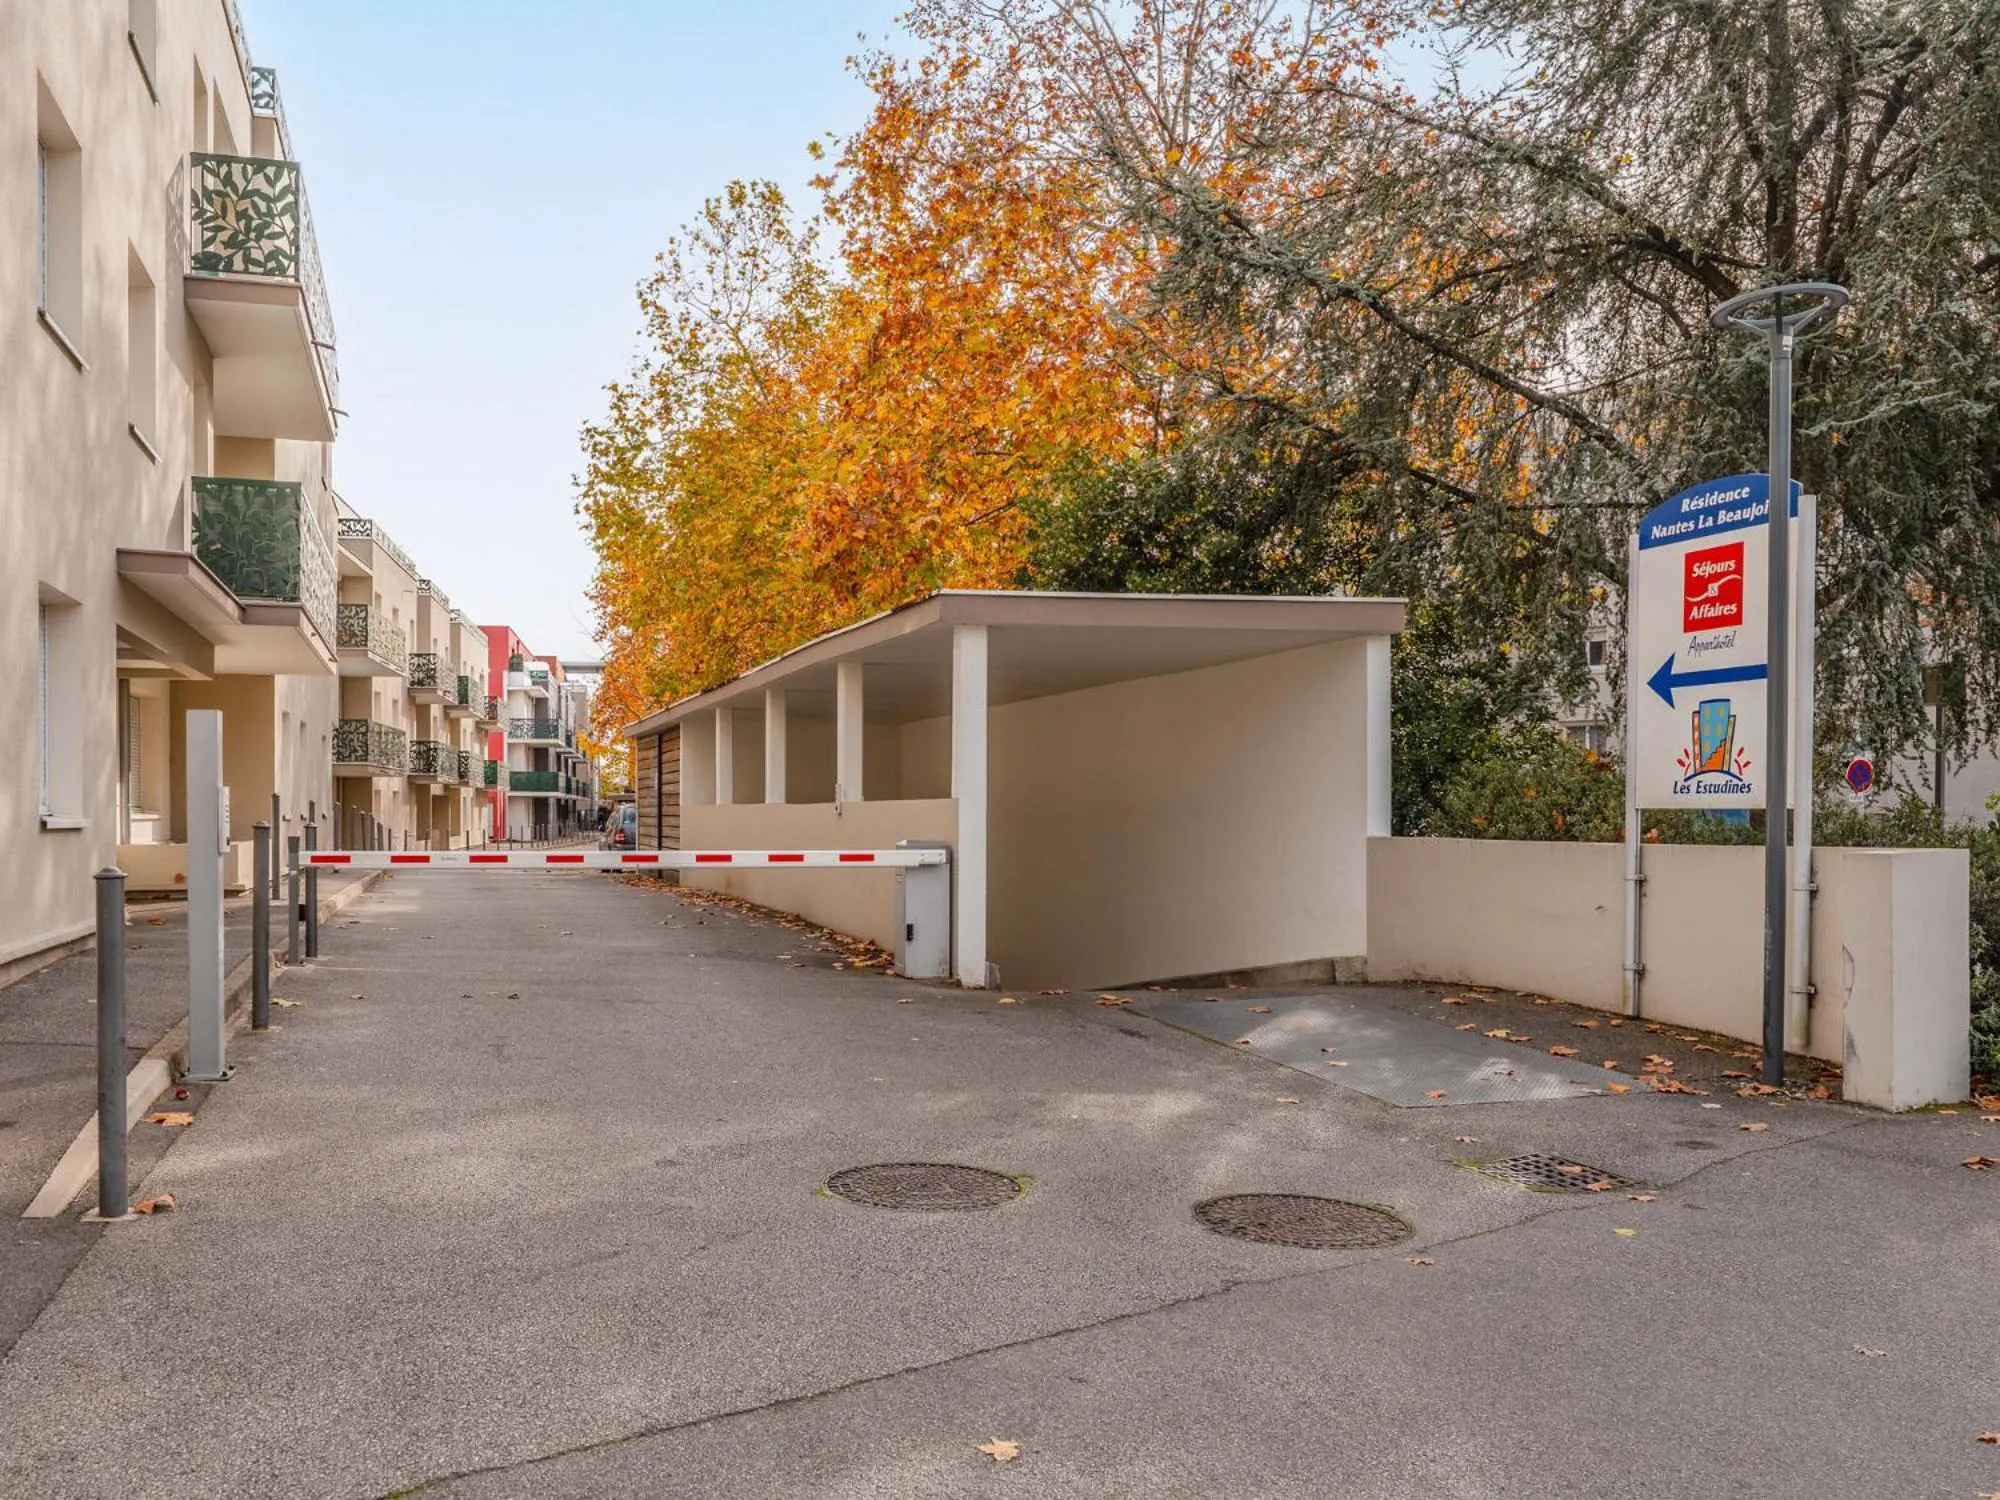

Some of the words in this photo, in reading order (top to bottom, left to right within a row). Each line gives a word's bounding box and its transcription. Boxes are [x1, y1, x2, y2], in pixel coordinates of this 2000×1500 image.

[1681, 486, 1750, 513] Résidence
[1651, 520, 1695, 540] Nantes
[1698, 514, 1714, 530] La
[1717, 498, 1770, 525] Beaujoi
[1691, 559, 1737, 578] Séjours
[1688, 602, 1738, 620] Affaires
[1673, 781, 1691, 795] Les
[1696, 780, 1753, 795] Estudines
